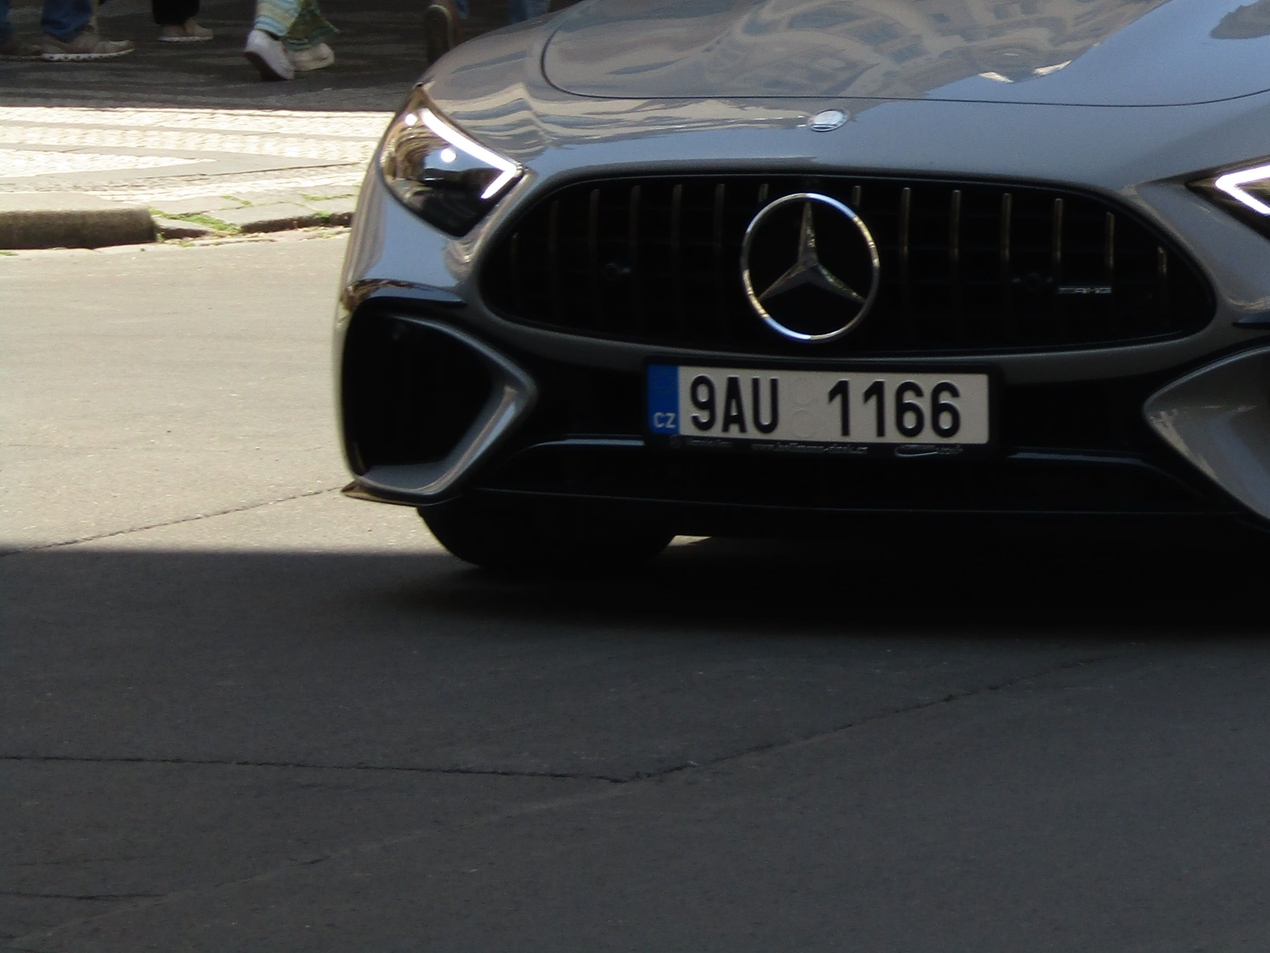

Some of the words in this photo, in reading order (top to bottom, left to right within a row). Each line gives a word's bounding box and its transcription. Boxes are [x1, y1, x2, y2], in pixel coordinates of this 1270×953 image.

[653, 411, 676, 429] CZ
[691, 375, 779, 434] 9AU
[828, 380, 961, 437] 1166
